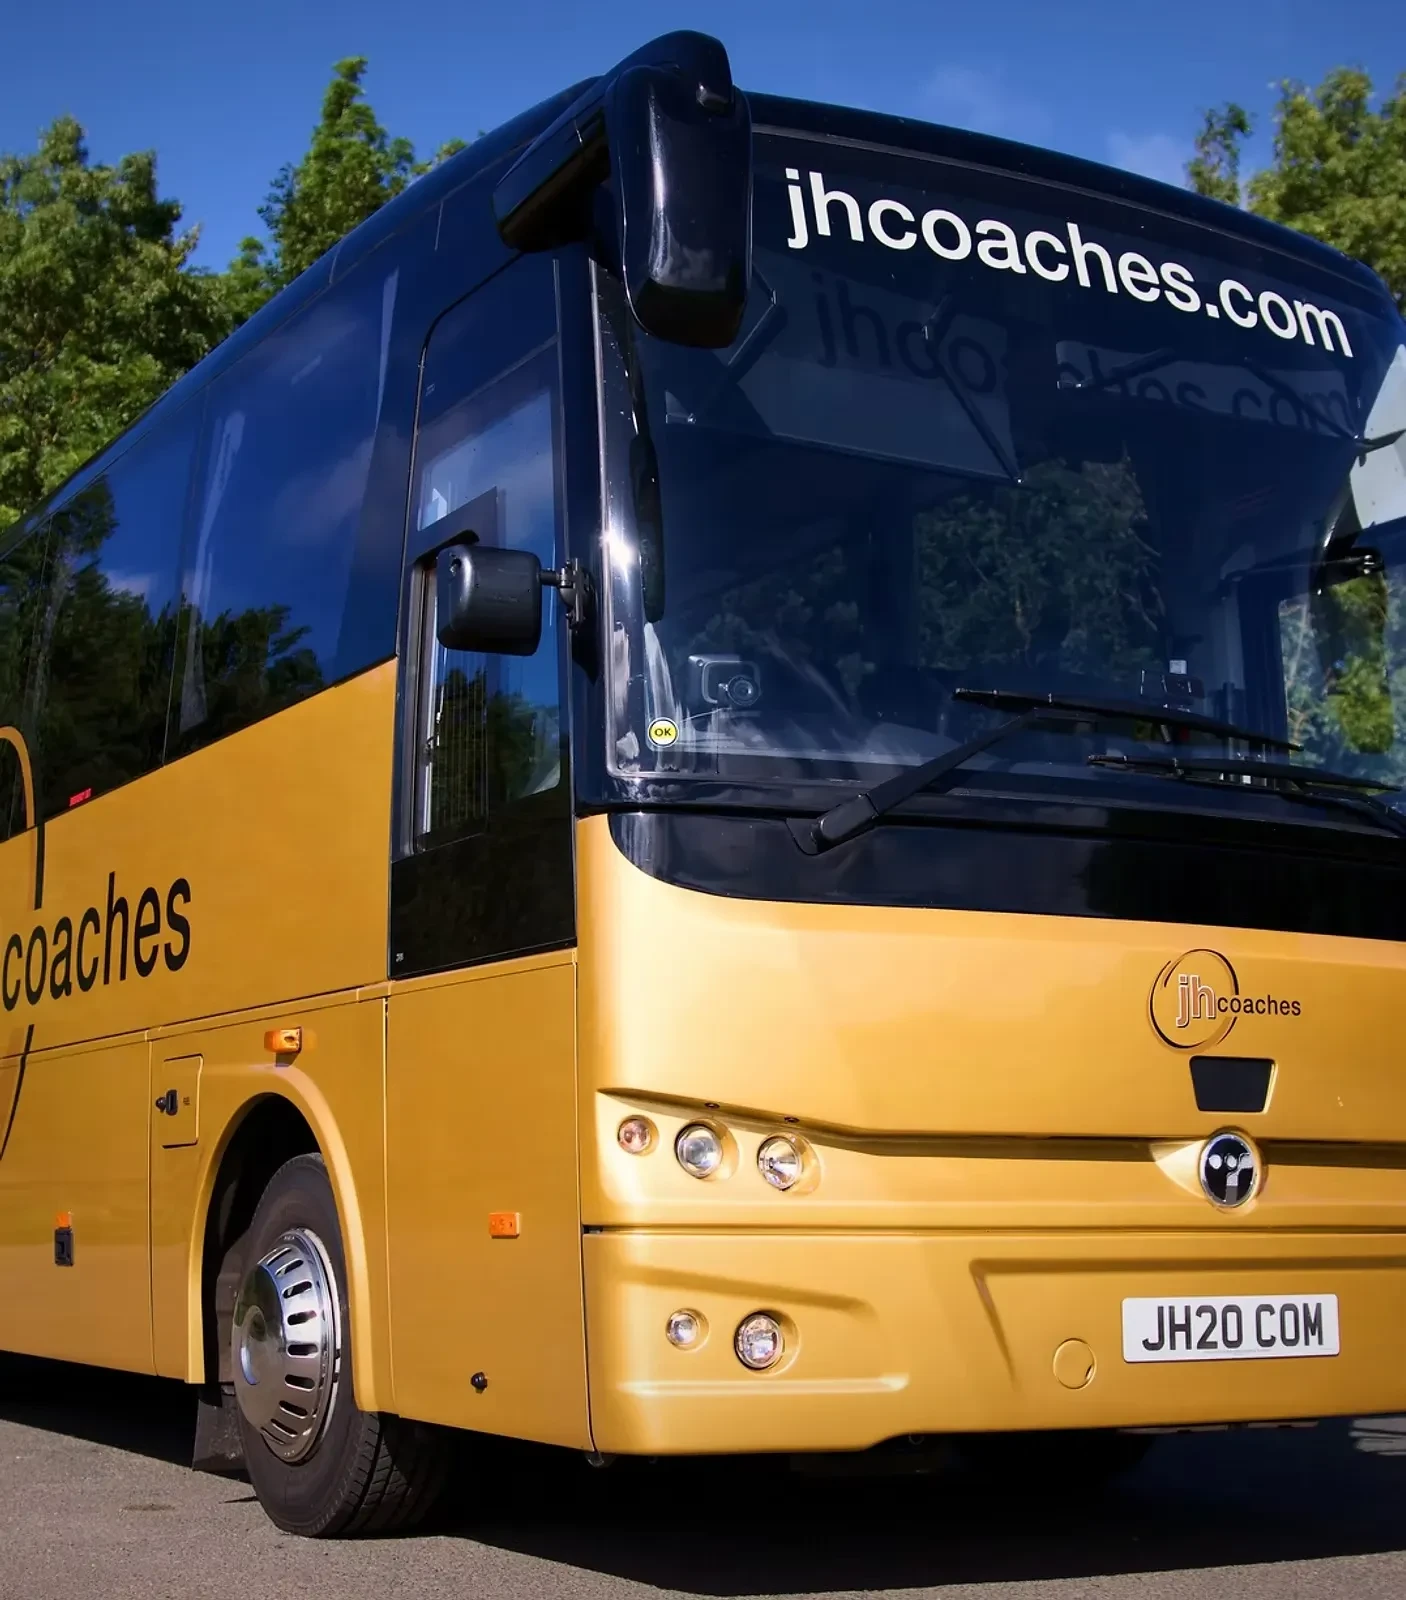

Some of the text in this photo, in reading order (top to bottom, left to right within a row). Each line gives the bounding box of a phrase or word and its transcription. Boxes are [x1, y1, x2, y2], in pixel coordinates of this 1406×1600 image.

[785, 167, 1354, 358] jhcoaches.com
[654, 727, 672, 737] OK
[2, 871, 191, 1011] coaches
[1217, 994, 1301, 1016] coaches
[1142, 1302, 1324, 1351] JH20 COM
